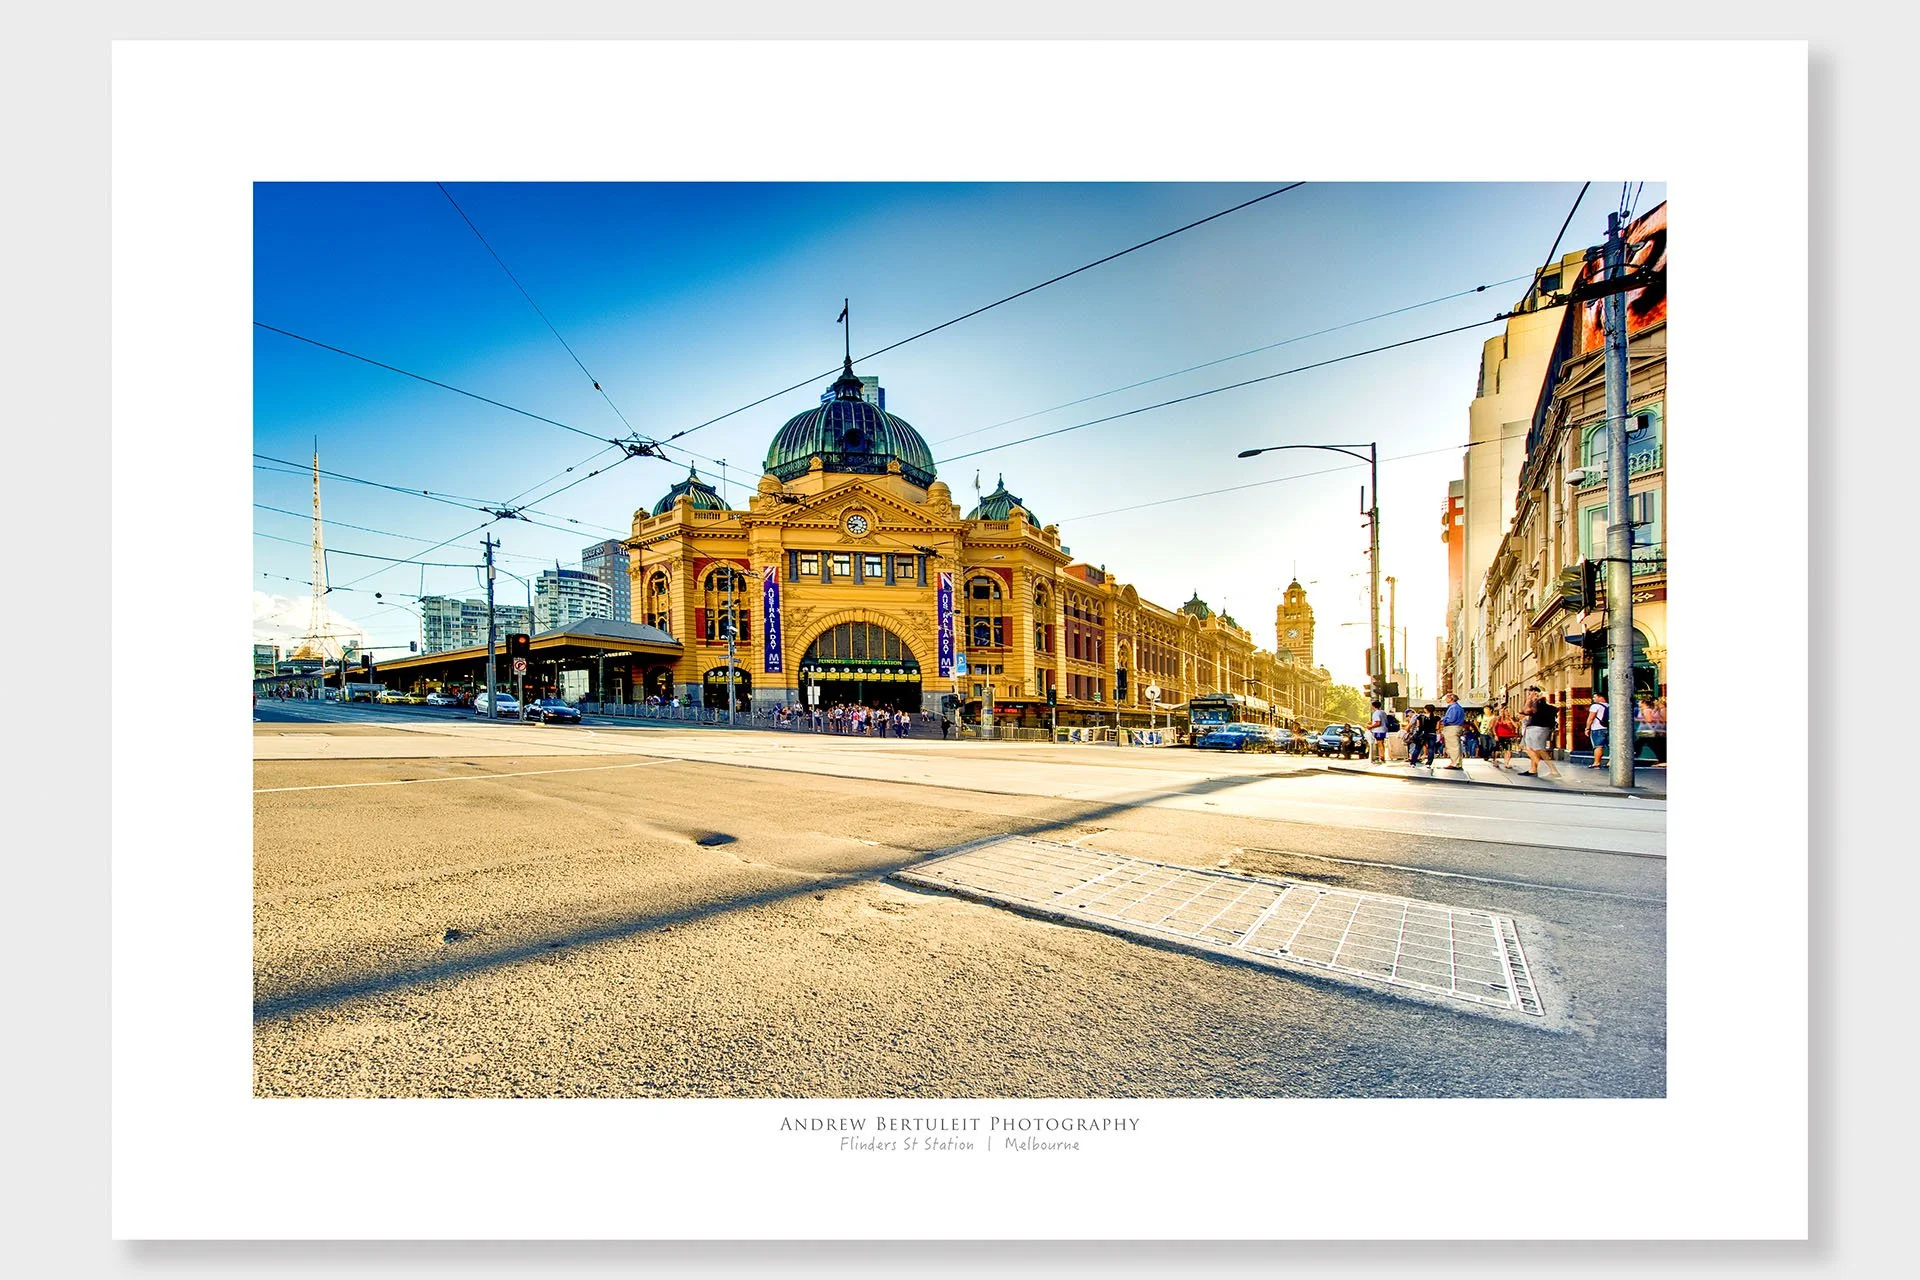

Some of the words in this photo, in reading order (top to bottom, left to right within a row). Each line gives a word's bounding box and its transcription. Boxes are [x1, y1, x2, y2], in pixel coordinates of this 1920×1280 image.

[768, 587, 776, 633] AUSTRALIA
[942, 593, 951, 638] AUSRALIA
[769, 635, 777, 650] DAY
[942, 639, 950, 655] DAY
